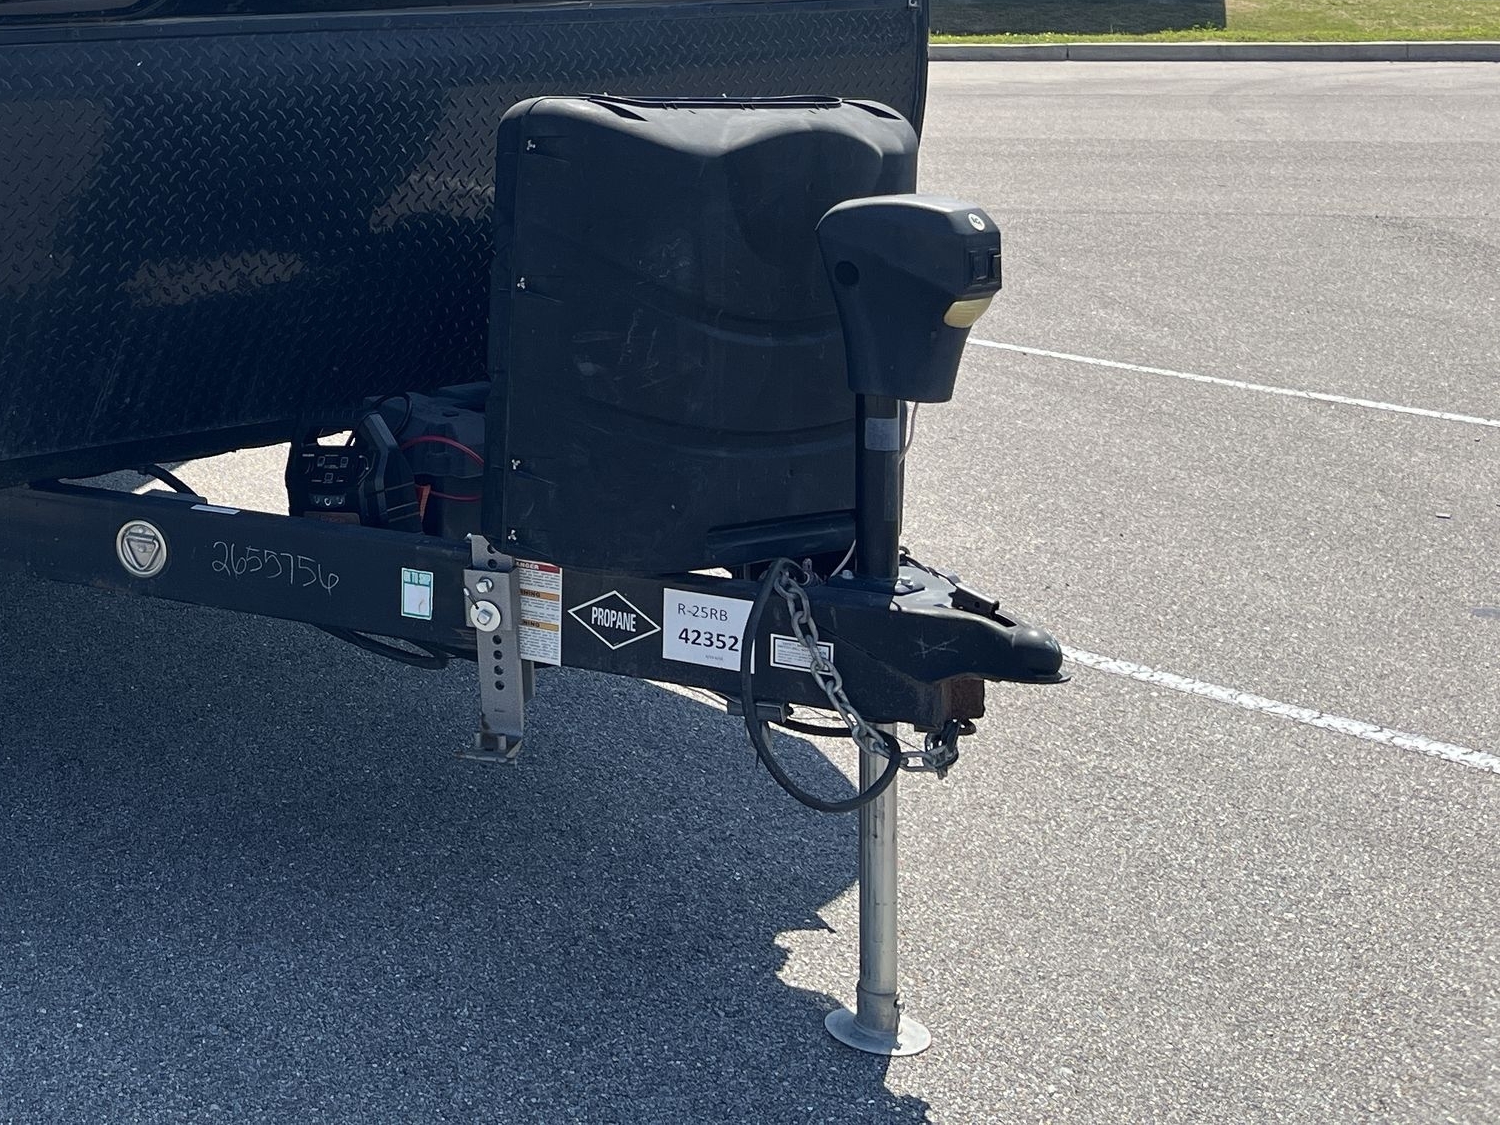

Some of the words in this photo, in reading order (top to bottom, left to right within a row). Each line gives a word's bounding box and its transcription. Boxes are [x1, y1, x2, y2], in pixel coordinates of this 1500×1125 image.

[211, 540, 340, 596] 2655756
[516, 561, 540, 571] ANGER
[591, 606, 637, 633] PROPANE
[677, 602, 729, 623] R-25RB
[678, 628, 740, 653] 42352
